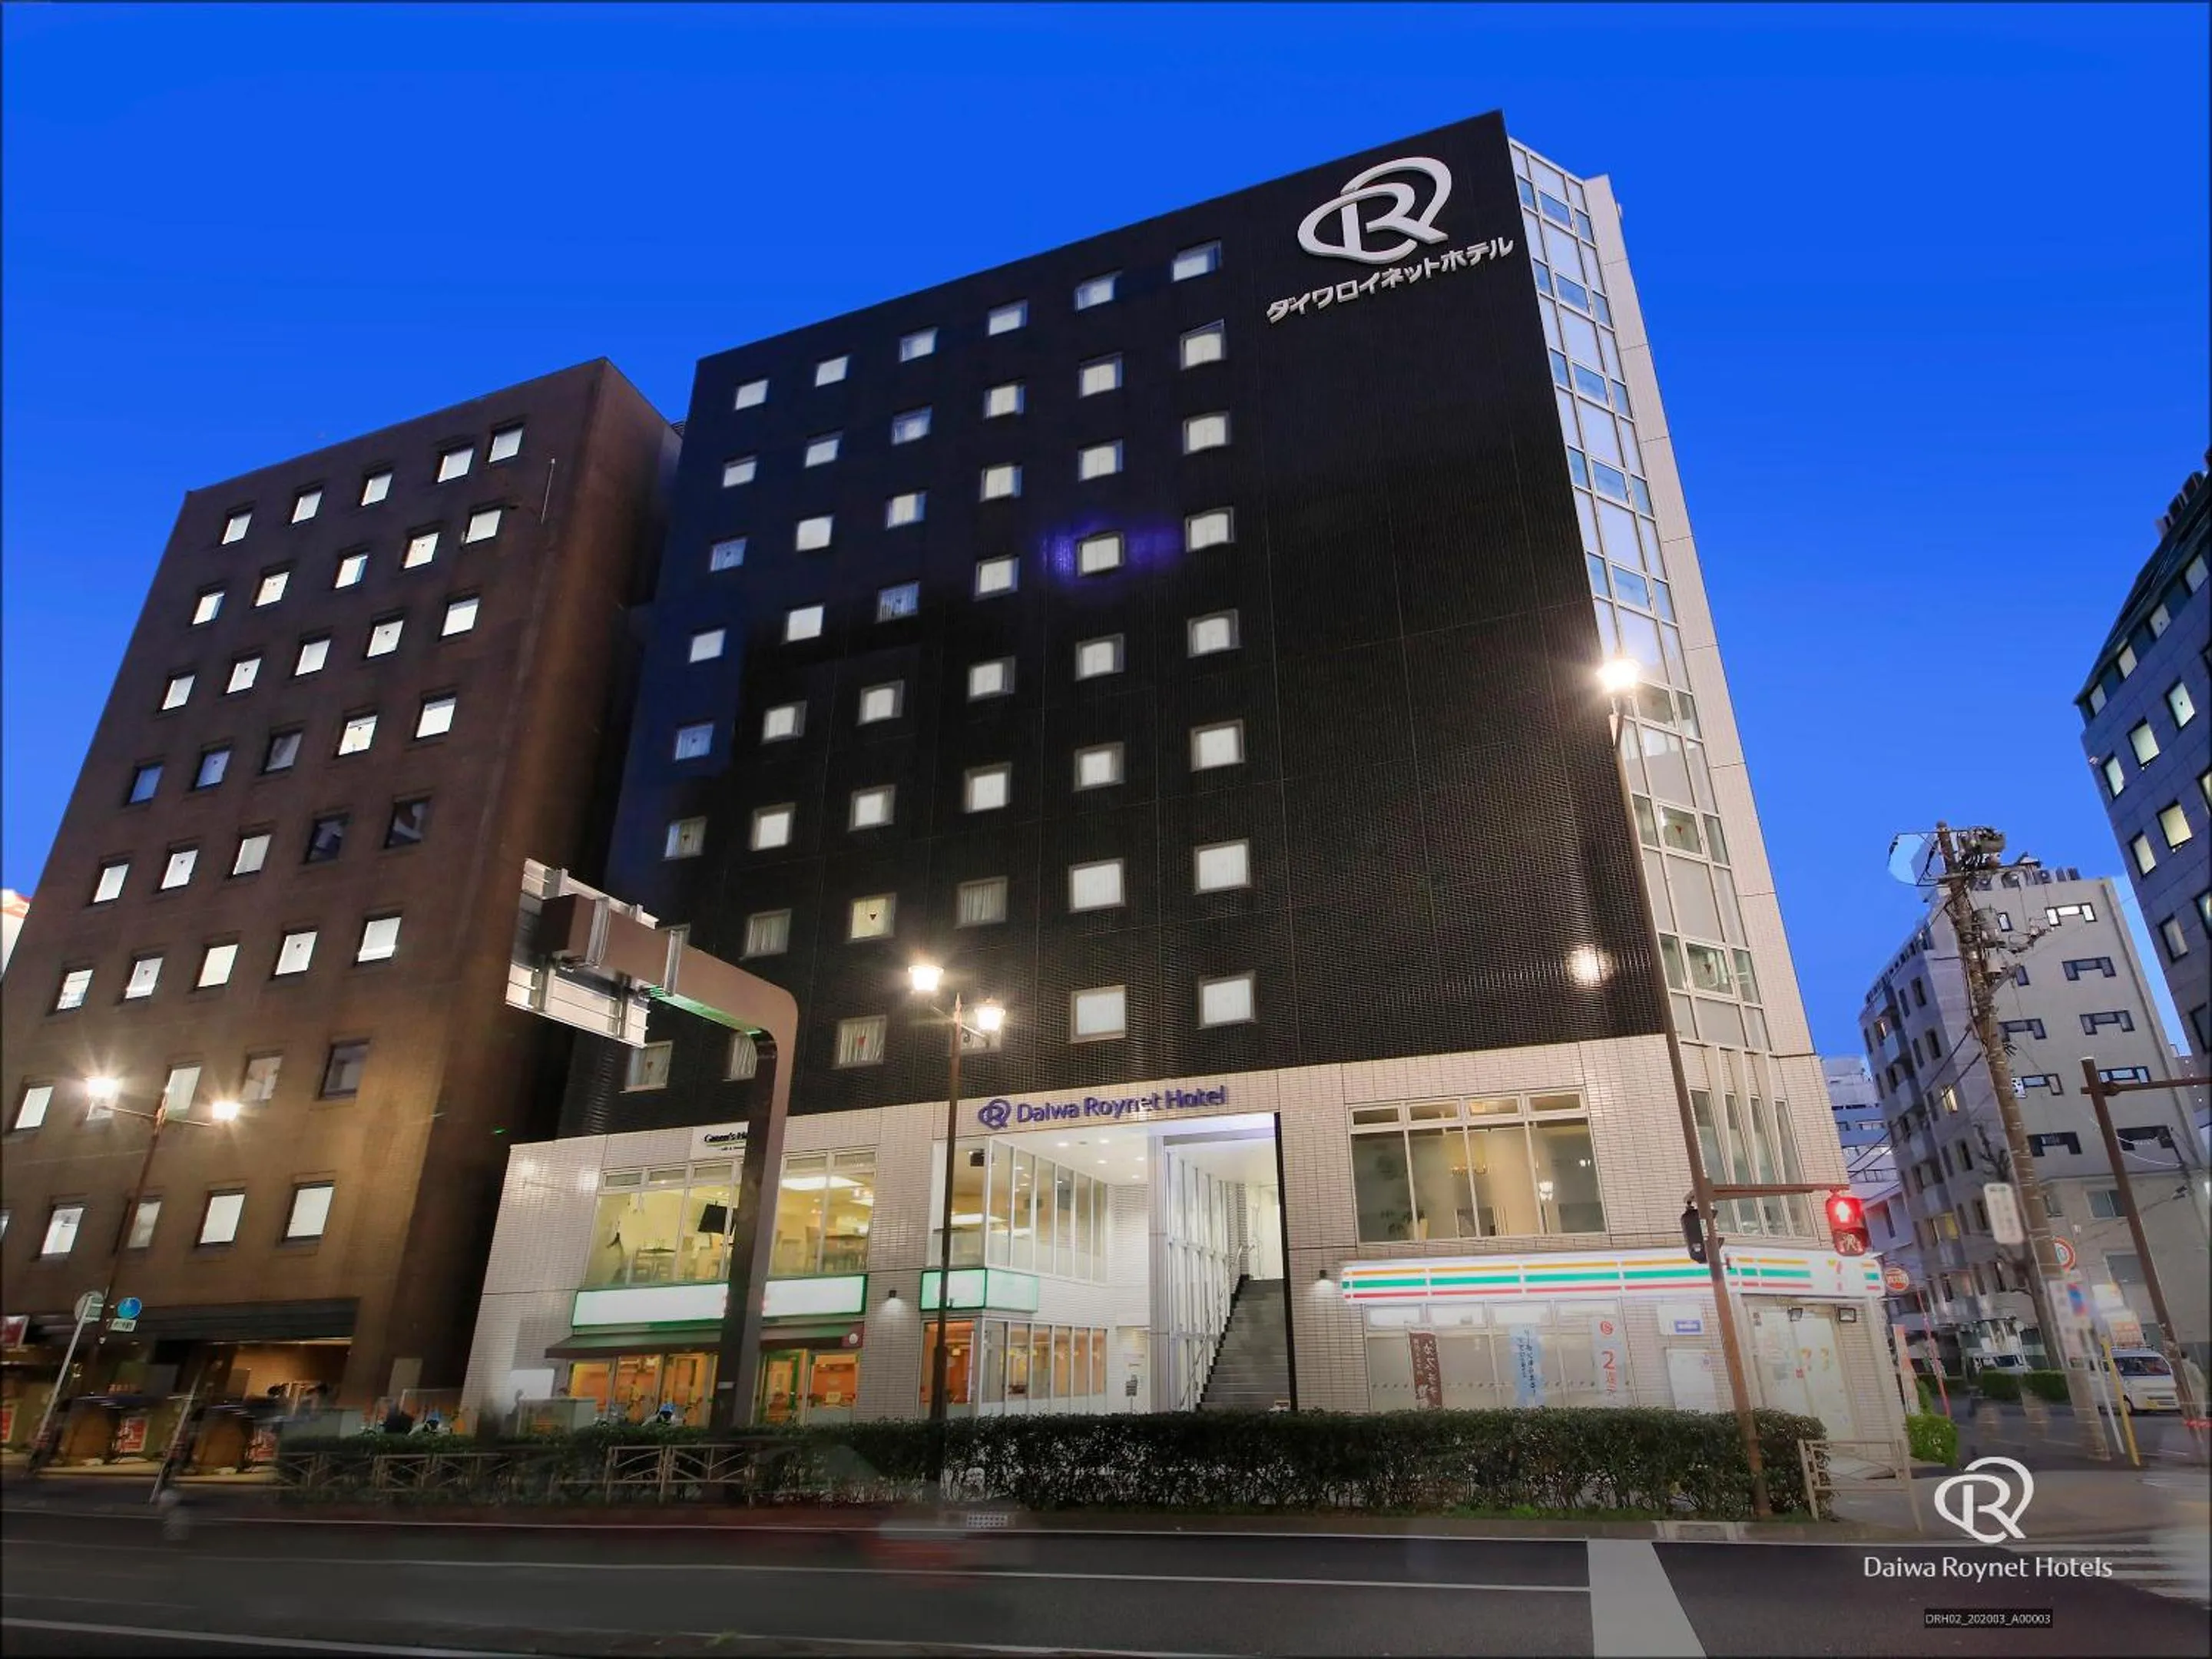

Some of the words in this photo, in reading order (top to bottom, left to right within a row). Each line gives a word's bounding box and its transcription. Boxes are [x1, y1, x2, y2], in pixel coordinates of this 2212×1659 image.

[1266, 236, 1515, 323] ダイワロイネットホテル
[1015, 1102, 1080, 1123] Daiwa
[1083, 1092, 1161, 1120] Roynet
[1164, 1084, 1227, 1109] Hotel
